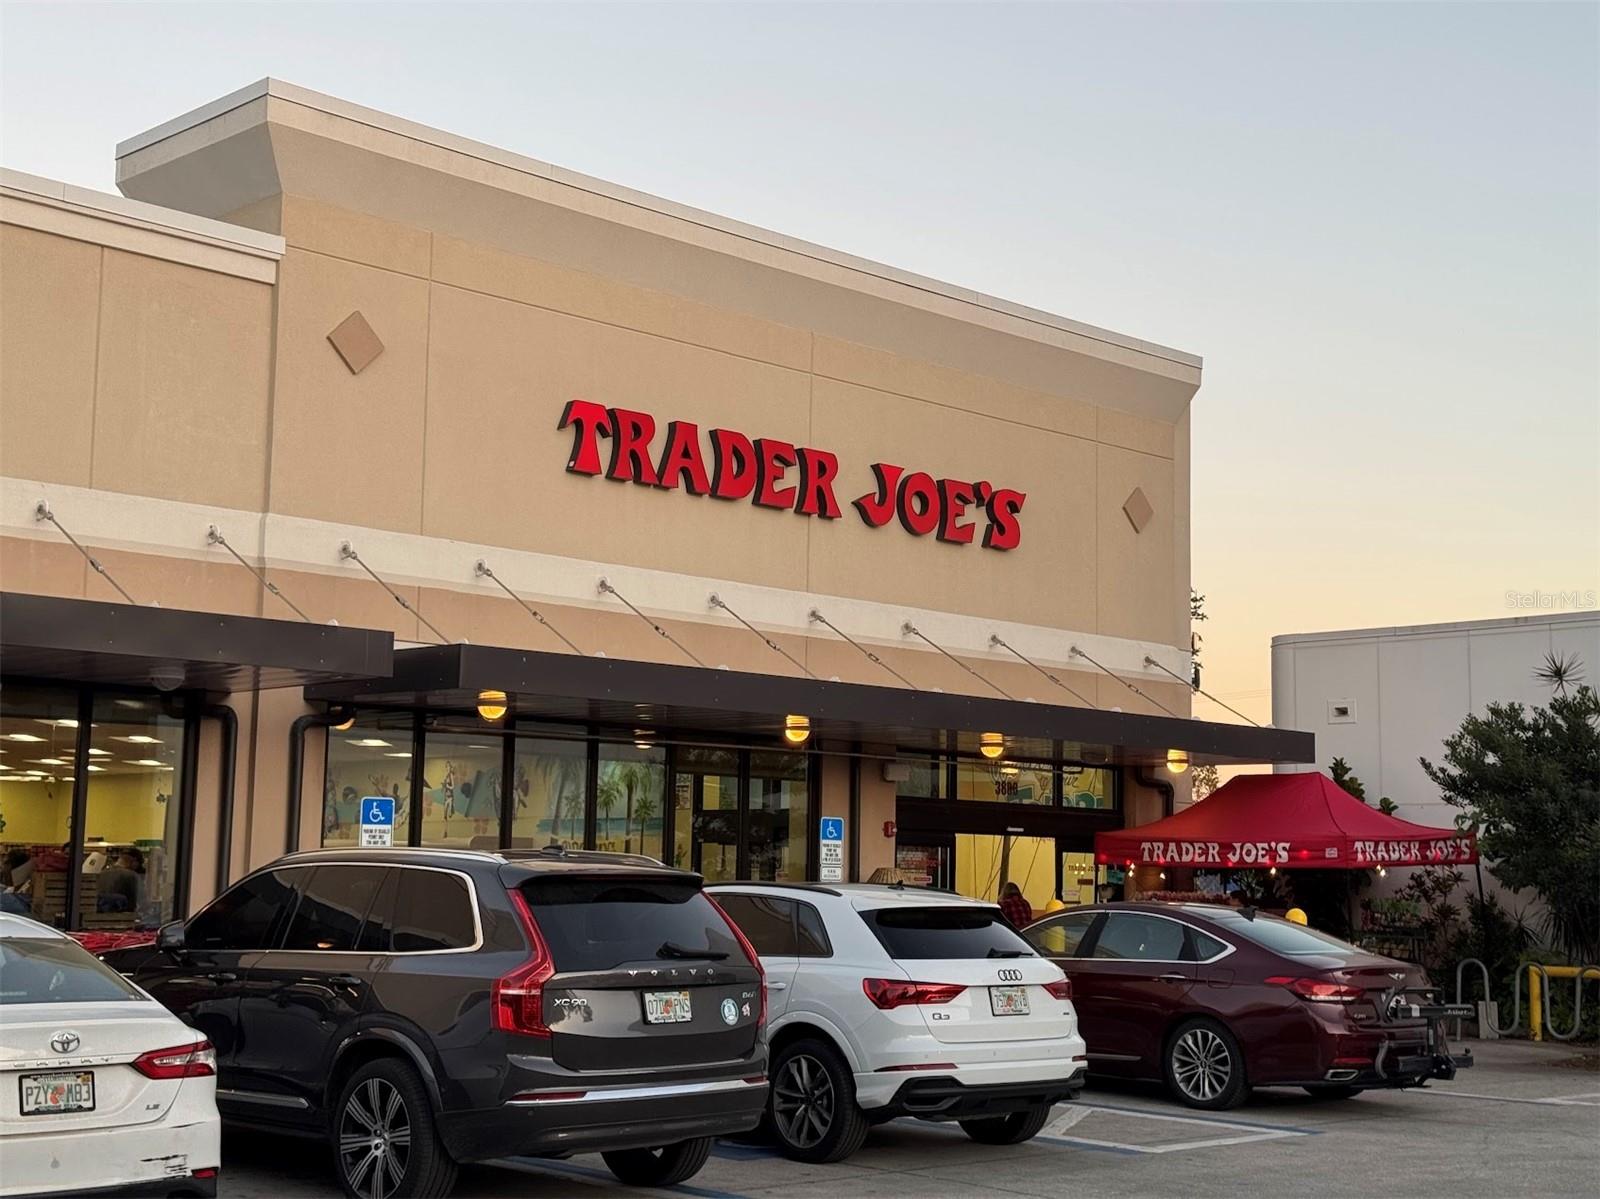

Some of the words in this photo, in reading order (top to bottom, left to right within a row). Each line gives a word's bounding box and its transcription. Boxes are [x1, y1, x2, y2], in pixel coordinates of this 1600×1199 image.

[557, 400, 842, 519] TRADER
[851, 463, 1026, 550] JOE'S
[1140, 841, 1222, 863] TRADER
[1228, 841, 1291, 863] JOE'S
[1353, 839, 1420, 862] TRADER
[1425, 839, 1472, 861] JOE'S
[628, 968, 714, 977] VOLVO
[553, 998, 588, 1007] XC90
